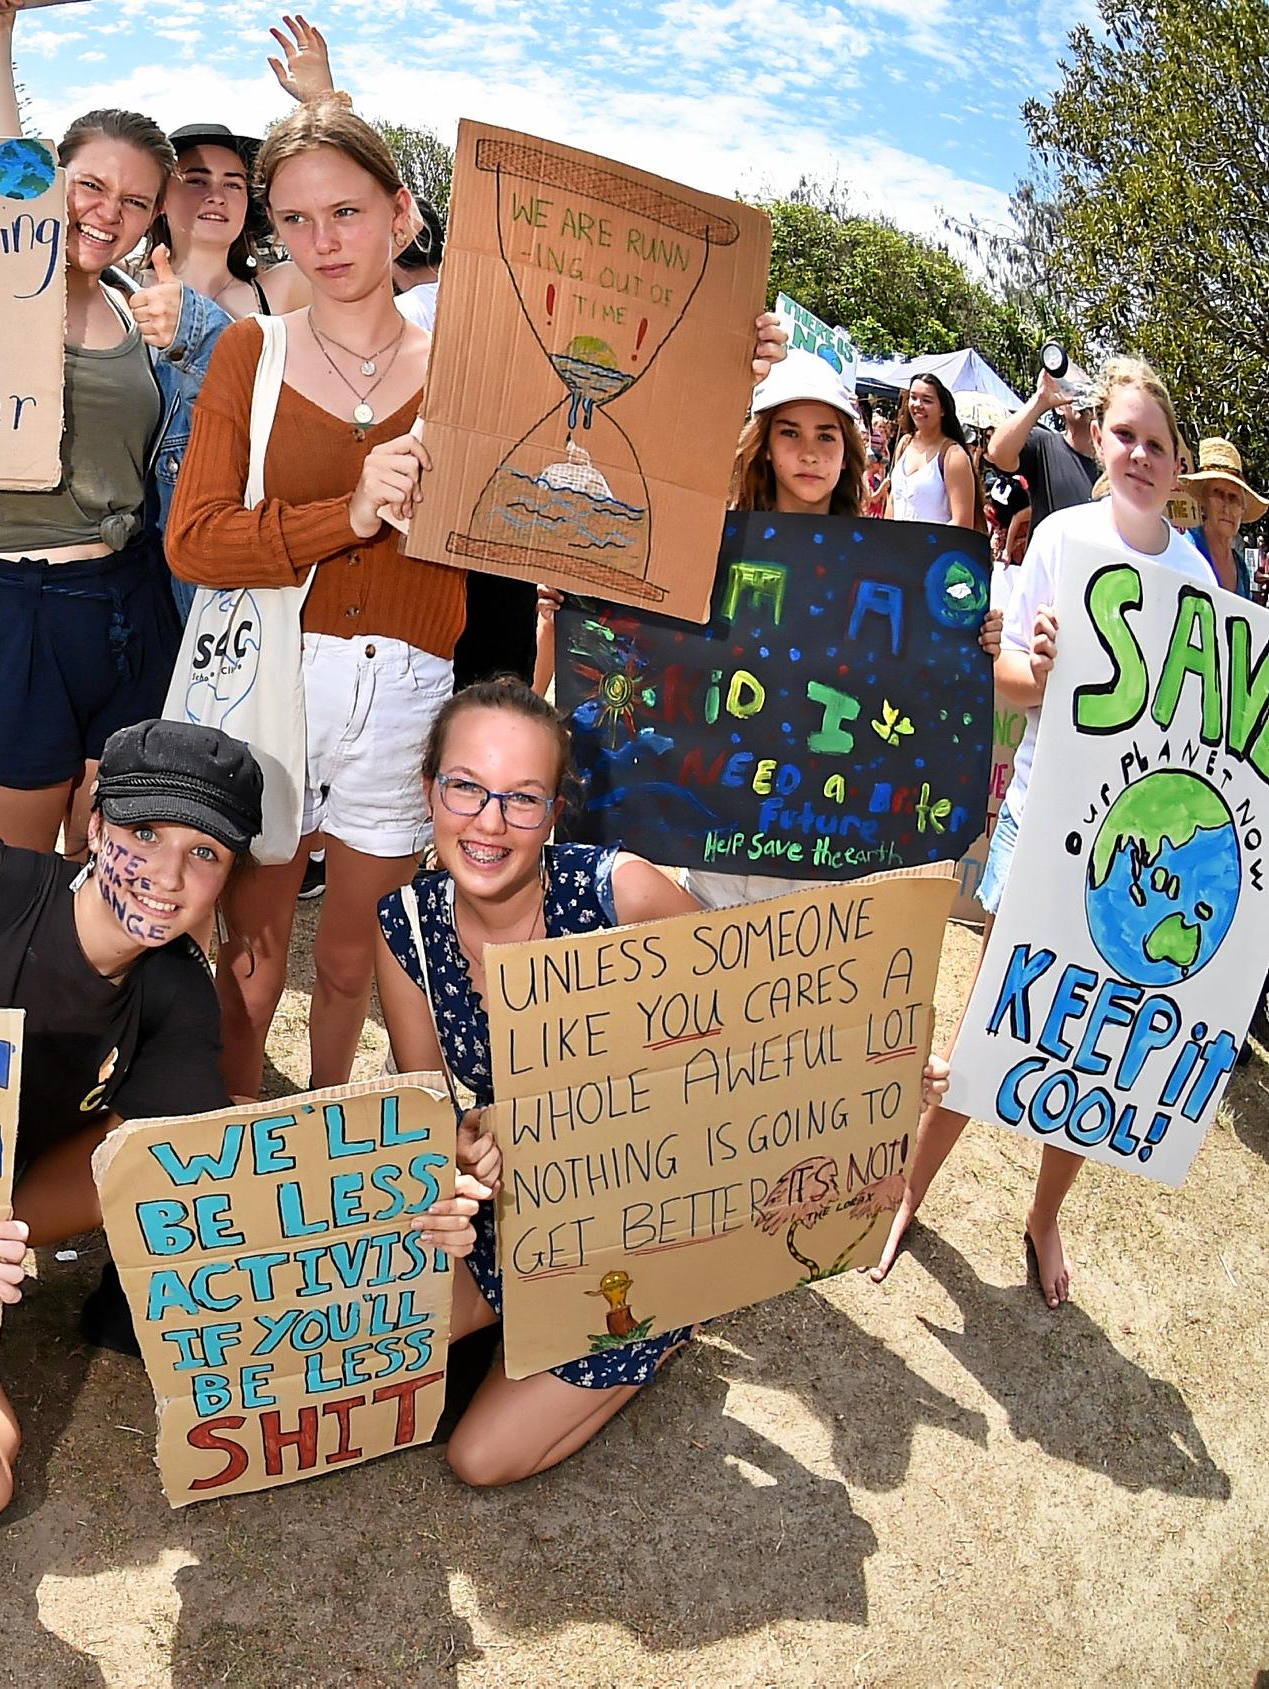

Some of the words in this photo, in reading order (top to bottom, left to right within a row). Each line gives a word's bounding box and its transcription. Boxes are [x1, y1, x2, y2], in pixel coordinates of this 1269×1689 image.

[513, 193, 554, 228] WE
[561, 208, 612, 248] ARE
[627, 228, 690, 272] RUNN
[600, 266, 643, 302] OUT
[650, 284, 673, 307] OF
[780, 294, 835, 345] THERE
[193, 620, 253, 669] S4C
[807, 680, 861, 754] I
[677, 749, 802, 796] NEED
[823, 774, 845, 804] a
[747, 833, 804, 861] Save
[844, 841, 904, 864] earth
[1236, 798, 1263, 891] NOW
[501, 936, 667, 1012] UNLESS
[692, 897, 874, 976] SOMEONE
[509, 1011, 610, 1076] LIKE
[637, 989, 724, 1042] YOU
[744, 959, 858, 1024] CARES
[883, 947, 913, 999] A
[986, 943, 1181, 1091] KEEP
[1158, 1021, 1238, 1123] it
[512, 1069, 651, 1145] WHOLE
[683, 1024, 842, 1104] AWEFUL
[865, 1003, 922, 1057] LOT
[995, 1056, 1172, 1163] COOL!
[148, 1096, 430, 1186] WE'LL
[512, 1133, 679, 1215] NOTHING
[707, 1122, 737, 1166] IS
[748, 1098, 848, 1154] GOING
[863, 1081, 902, 1125] TO
[135, 1193, 245, 1257] BE
[276, 1153, 449, 1239] LESS
[512, 1215, 595, 1275] GET
[623, 1177, 769, 1251] BETTER
[806, 1206, 830, 1223] THE
[163, 1323, 242, 1372] IF
[252, 1292, 434, 1356] YOU'LL
[192, 1364, 279, 1418] BE
[304, 1328, 436, 1395] LESS
[186, 1370, 444, 1492] SHIT
